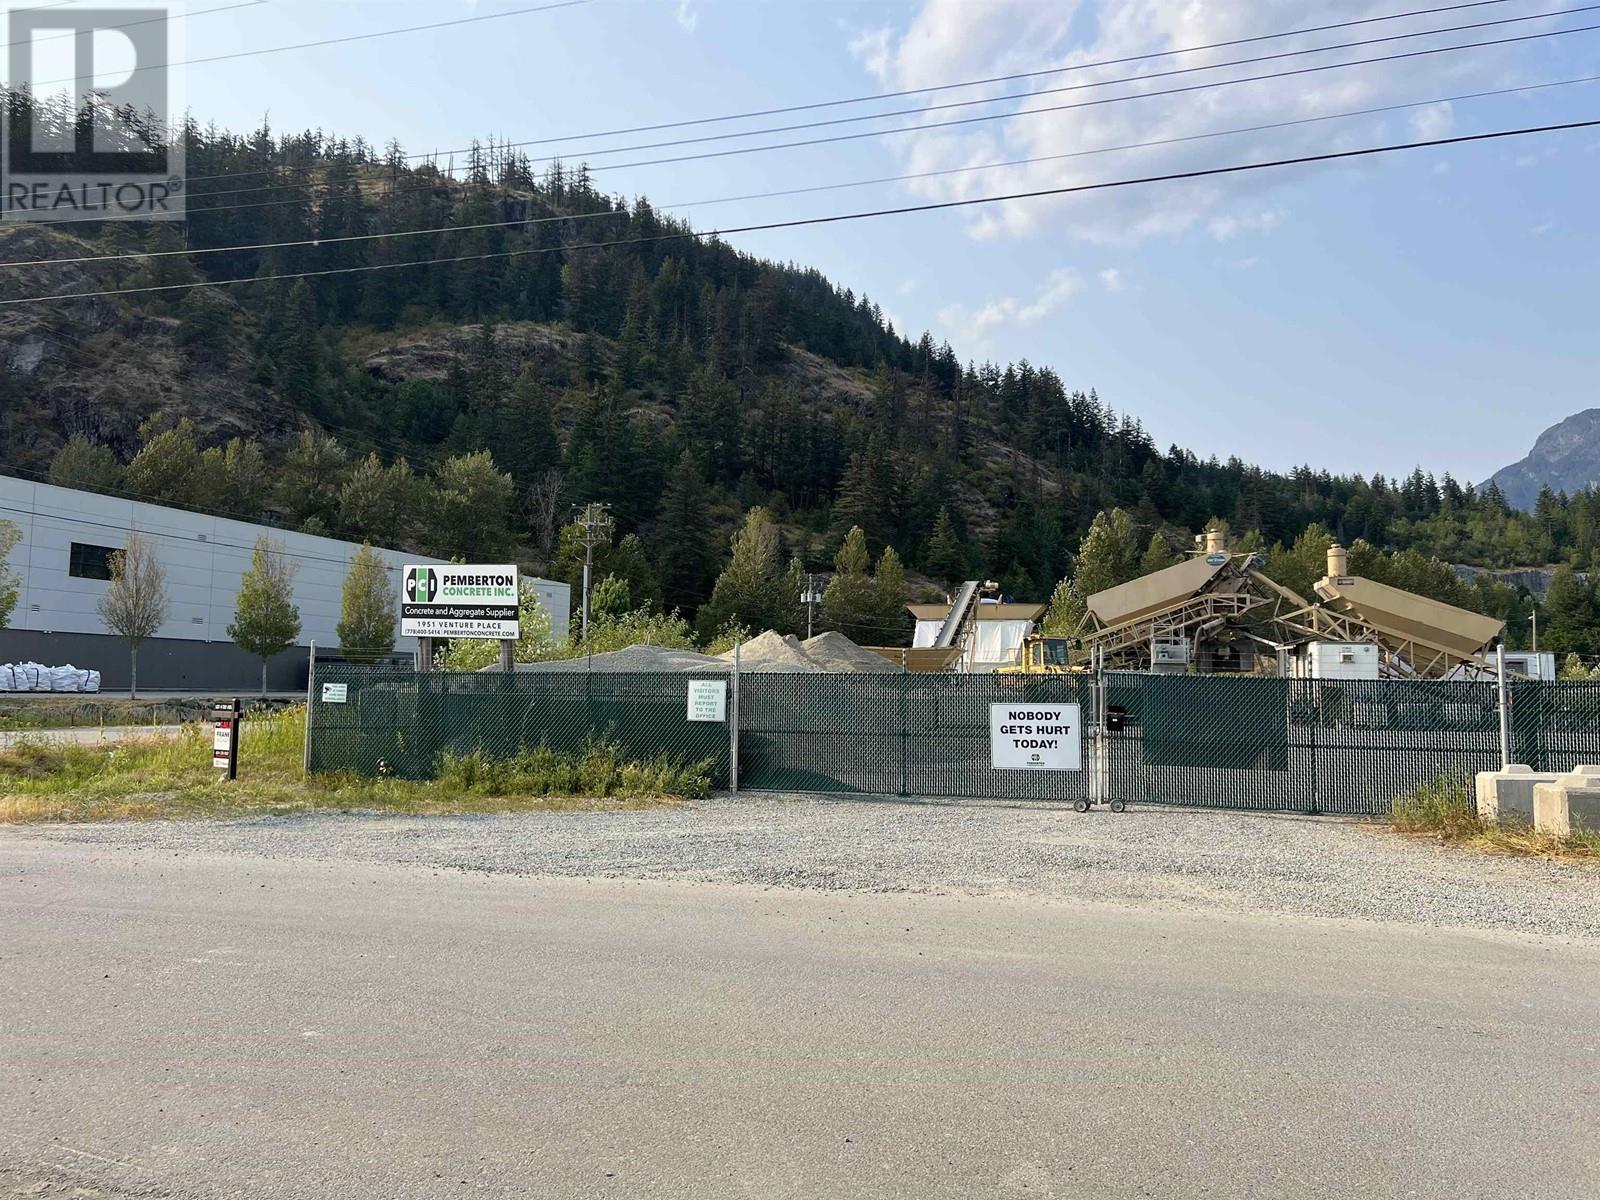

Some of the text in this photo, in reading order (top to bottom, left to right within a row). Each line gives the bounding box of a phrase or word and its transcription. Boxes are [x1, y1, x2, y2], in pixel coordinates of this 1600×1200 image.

[407, 579, 435, 592] PCI
[443, 575, 514, 586] PEMBERTON
[443, 587, 514, 596] CONCRETE INC.
[404, 606, 515, 618] Concrete and Aggregate Supplier
[1008, 711, 1061, 721] NOBODY
[1000, 725, 1071, 735] GETS HURT
[1013, 739, 1058, 749] TODAY!
